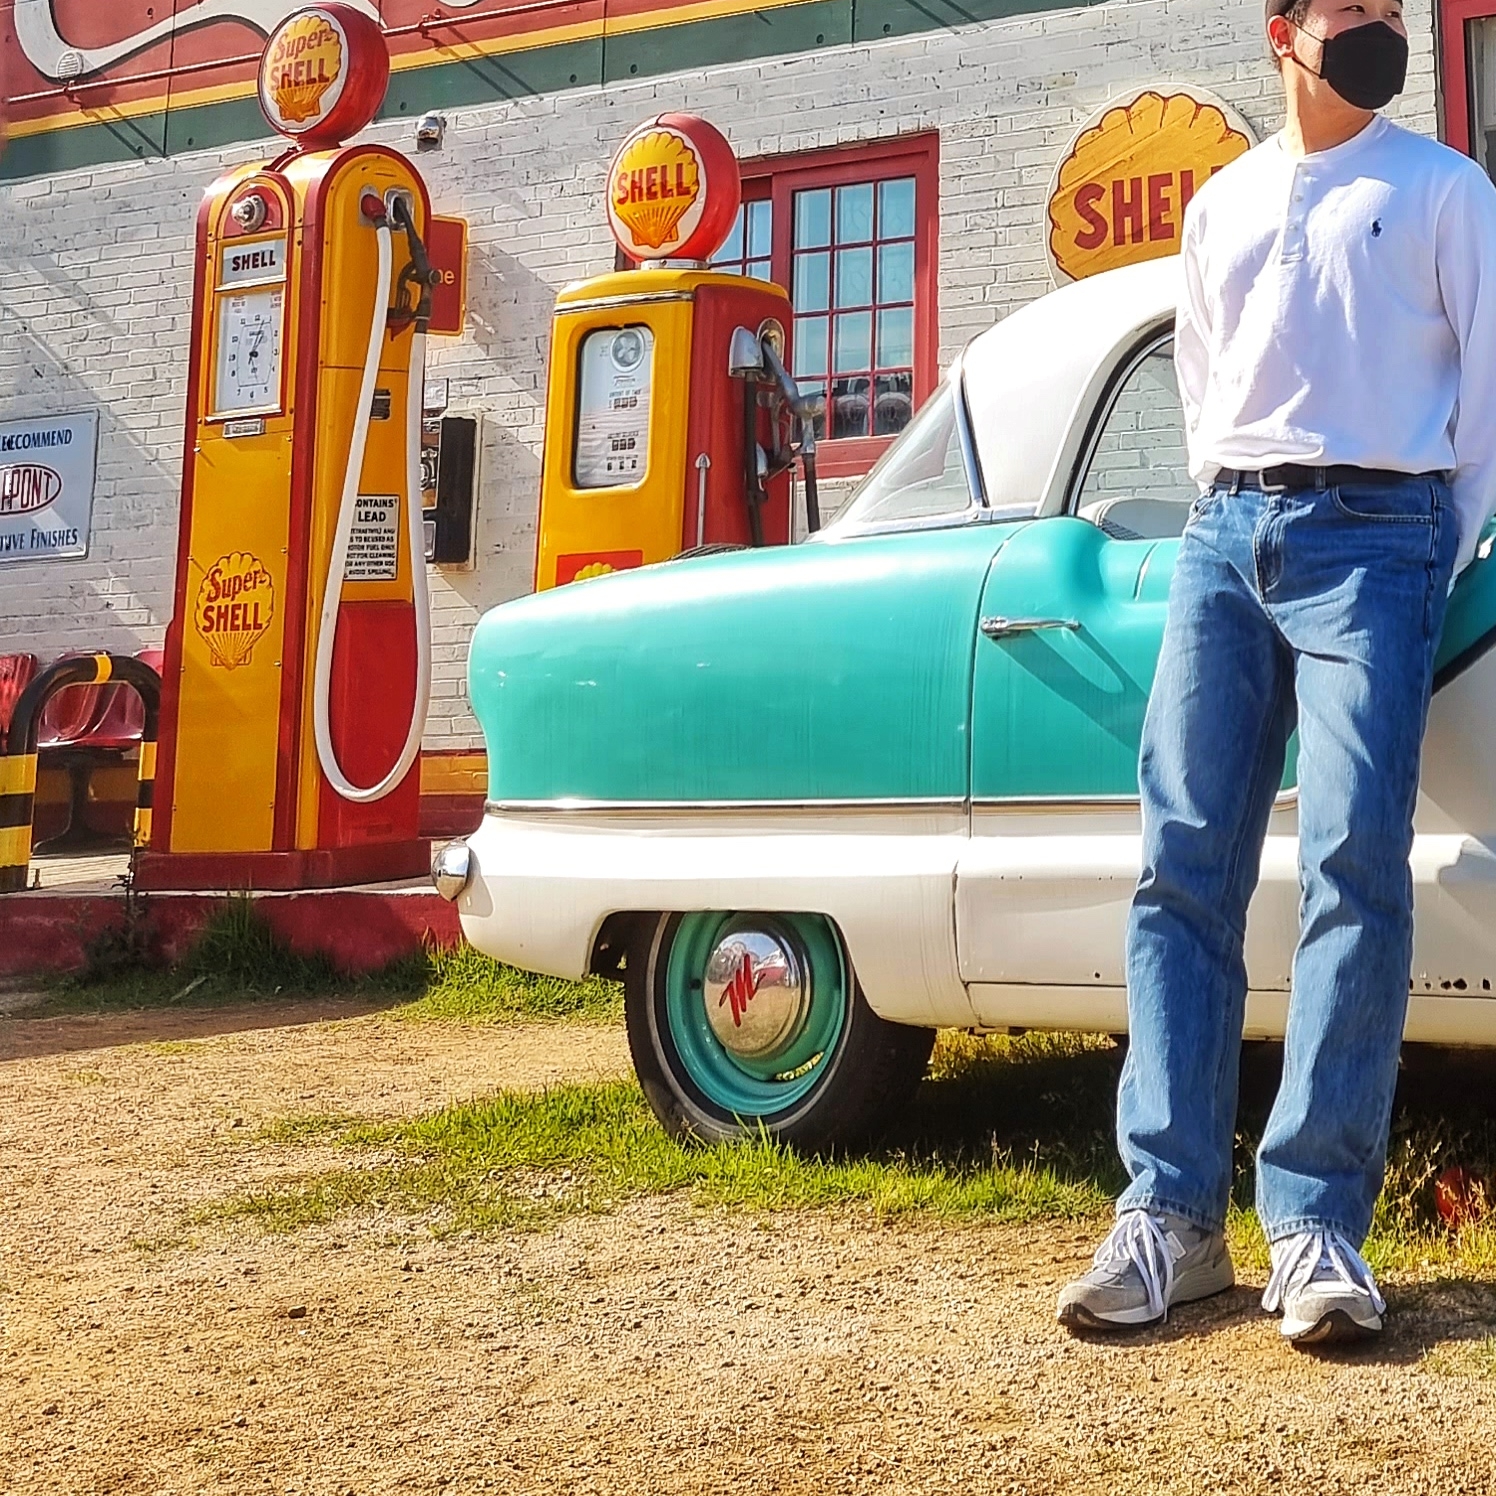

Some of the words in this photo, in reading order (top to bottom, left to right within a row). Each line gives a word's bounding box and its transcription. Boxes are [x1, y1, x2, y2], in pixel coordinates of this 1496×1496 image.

[270, 57, 330, 91] SHELL
[616, 163, 692, 205] SHELL
[232, 249, 276, 272] SHELL
[355, 498, 394, 508] ONTAINS
[358, 511, 386, 522] LEAD
[202, 602, 263, 633] SHELL
